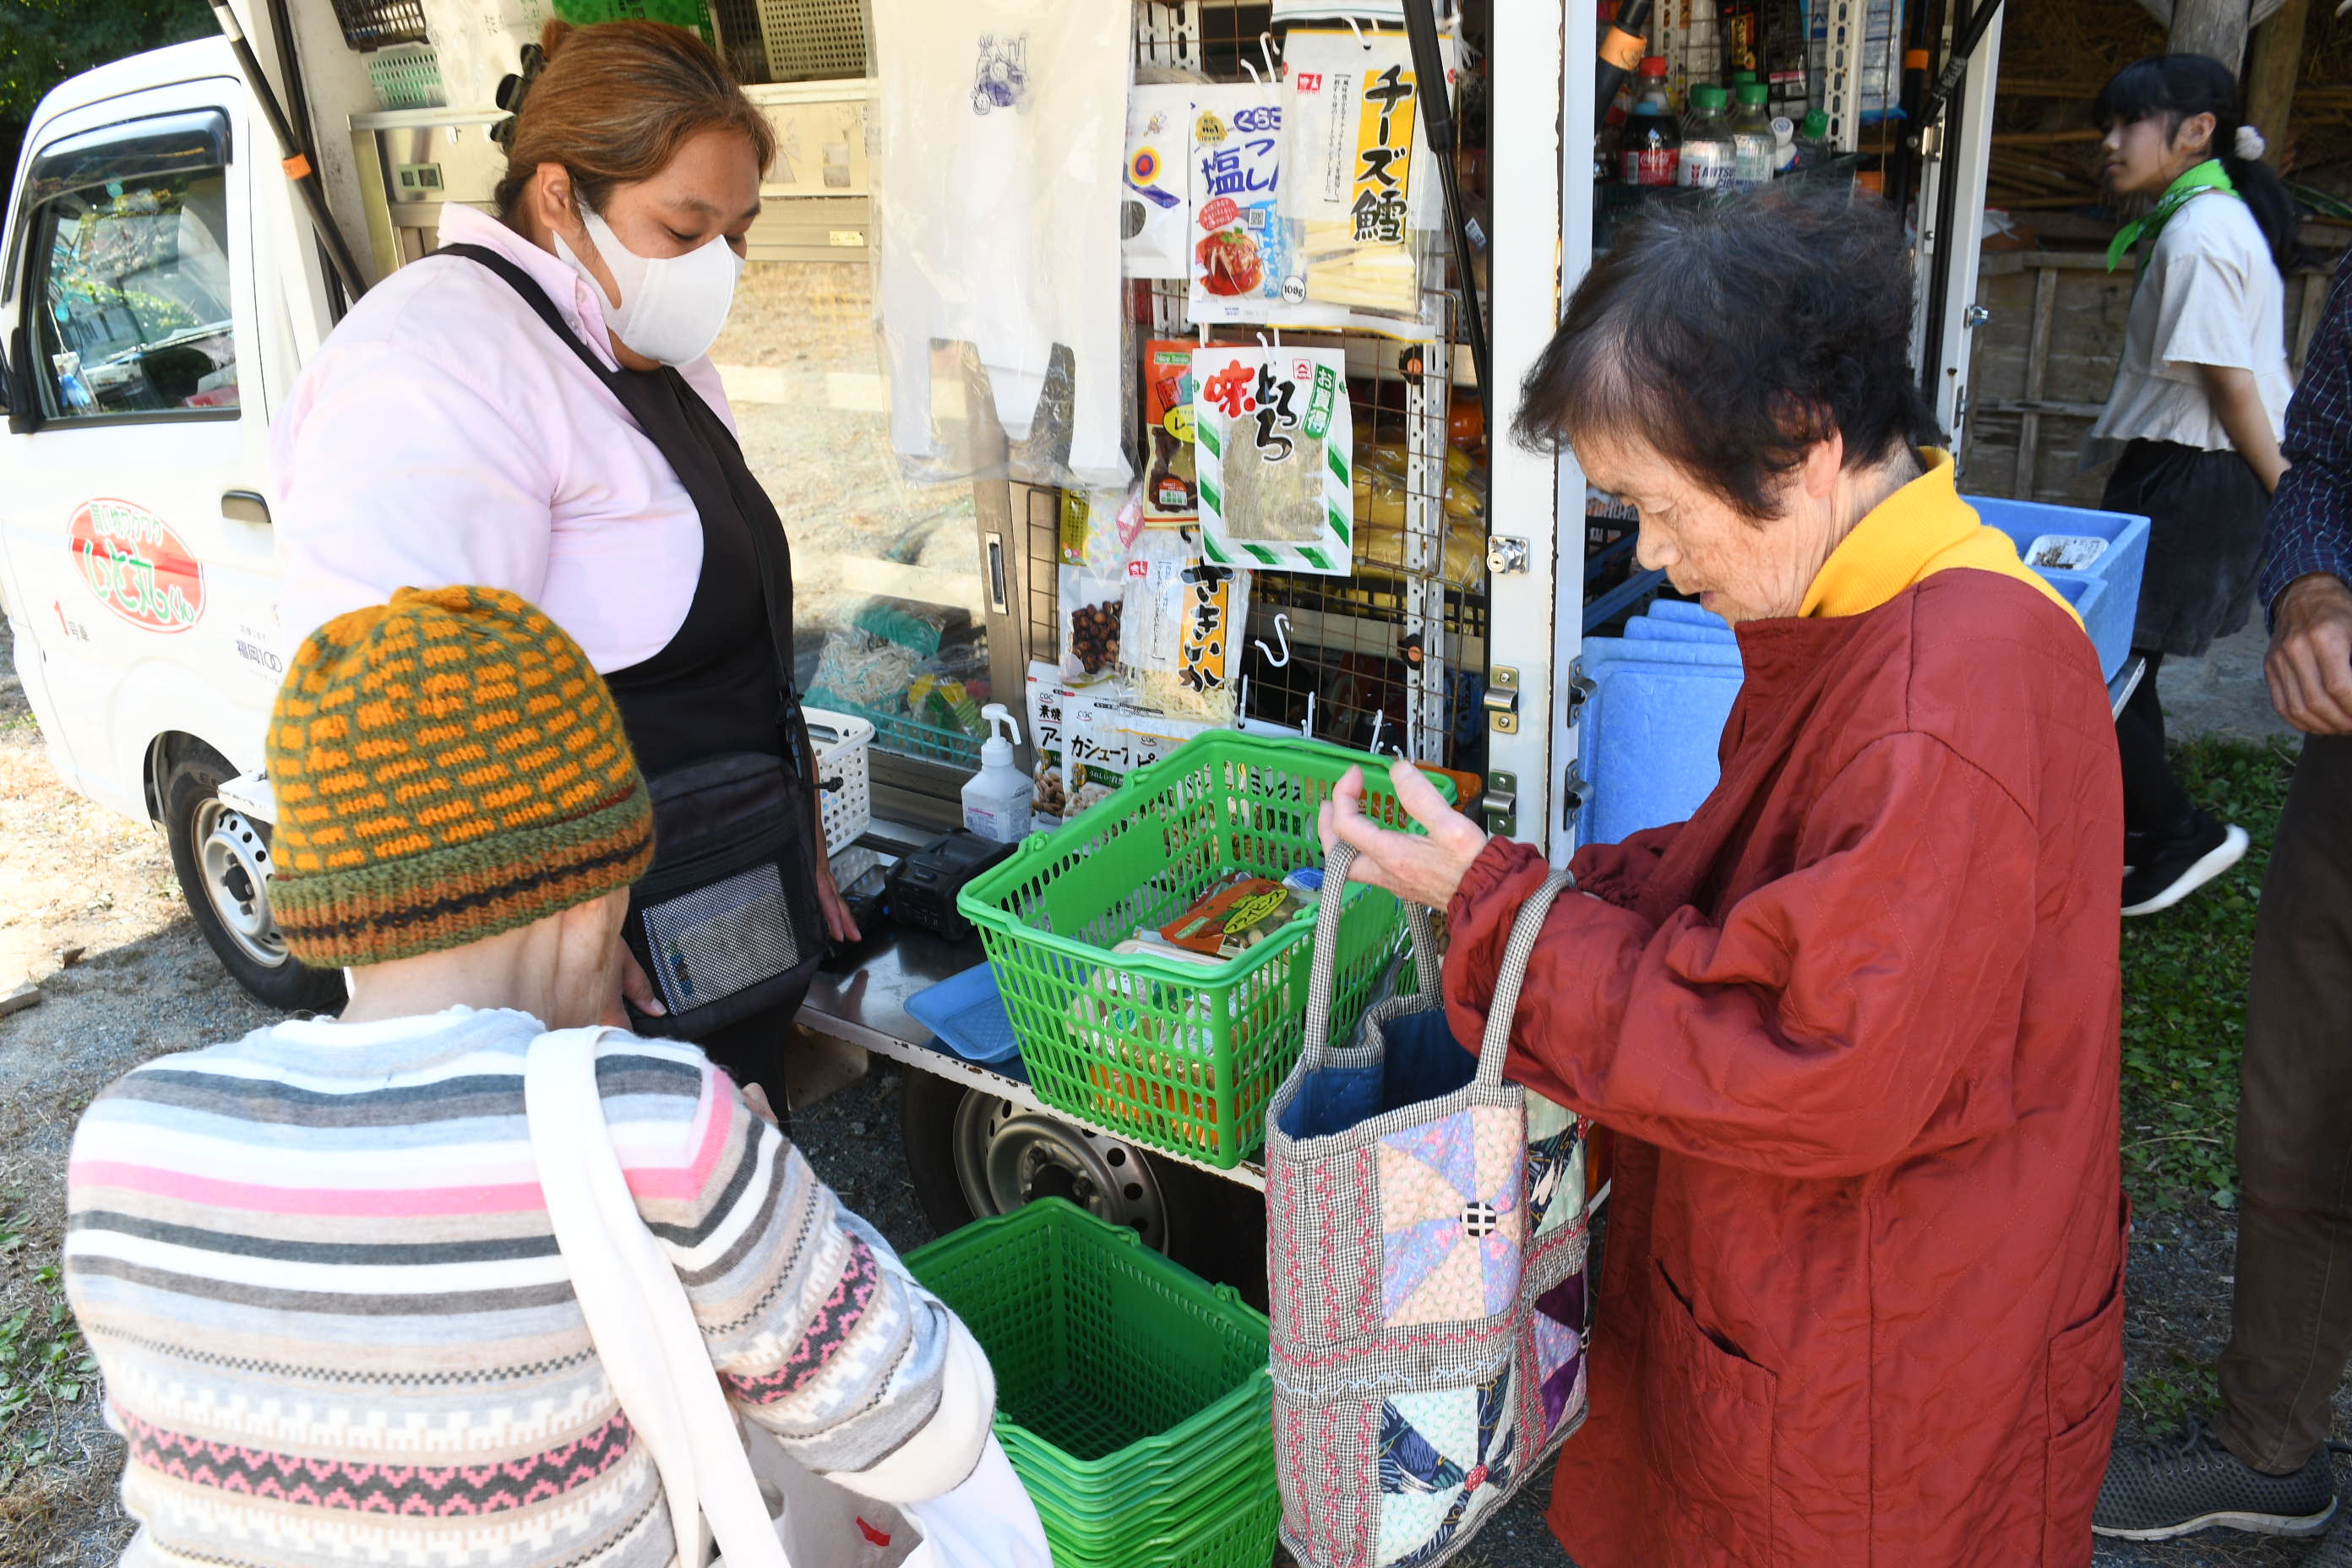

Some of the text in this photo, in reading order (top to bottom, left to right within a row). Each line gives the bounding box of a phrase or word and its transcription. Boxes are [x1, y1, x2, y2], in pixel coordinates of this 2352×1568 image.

[1352, 65, 1413, 244] チーズ鱈
[1203, 359, 1256, 419] 味
[1179, 556, 1235, 694] さきいか
[1040, 692, 1054, 700] CGC
[1141, 735, 1157, 743] CGC
